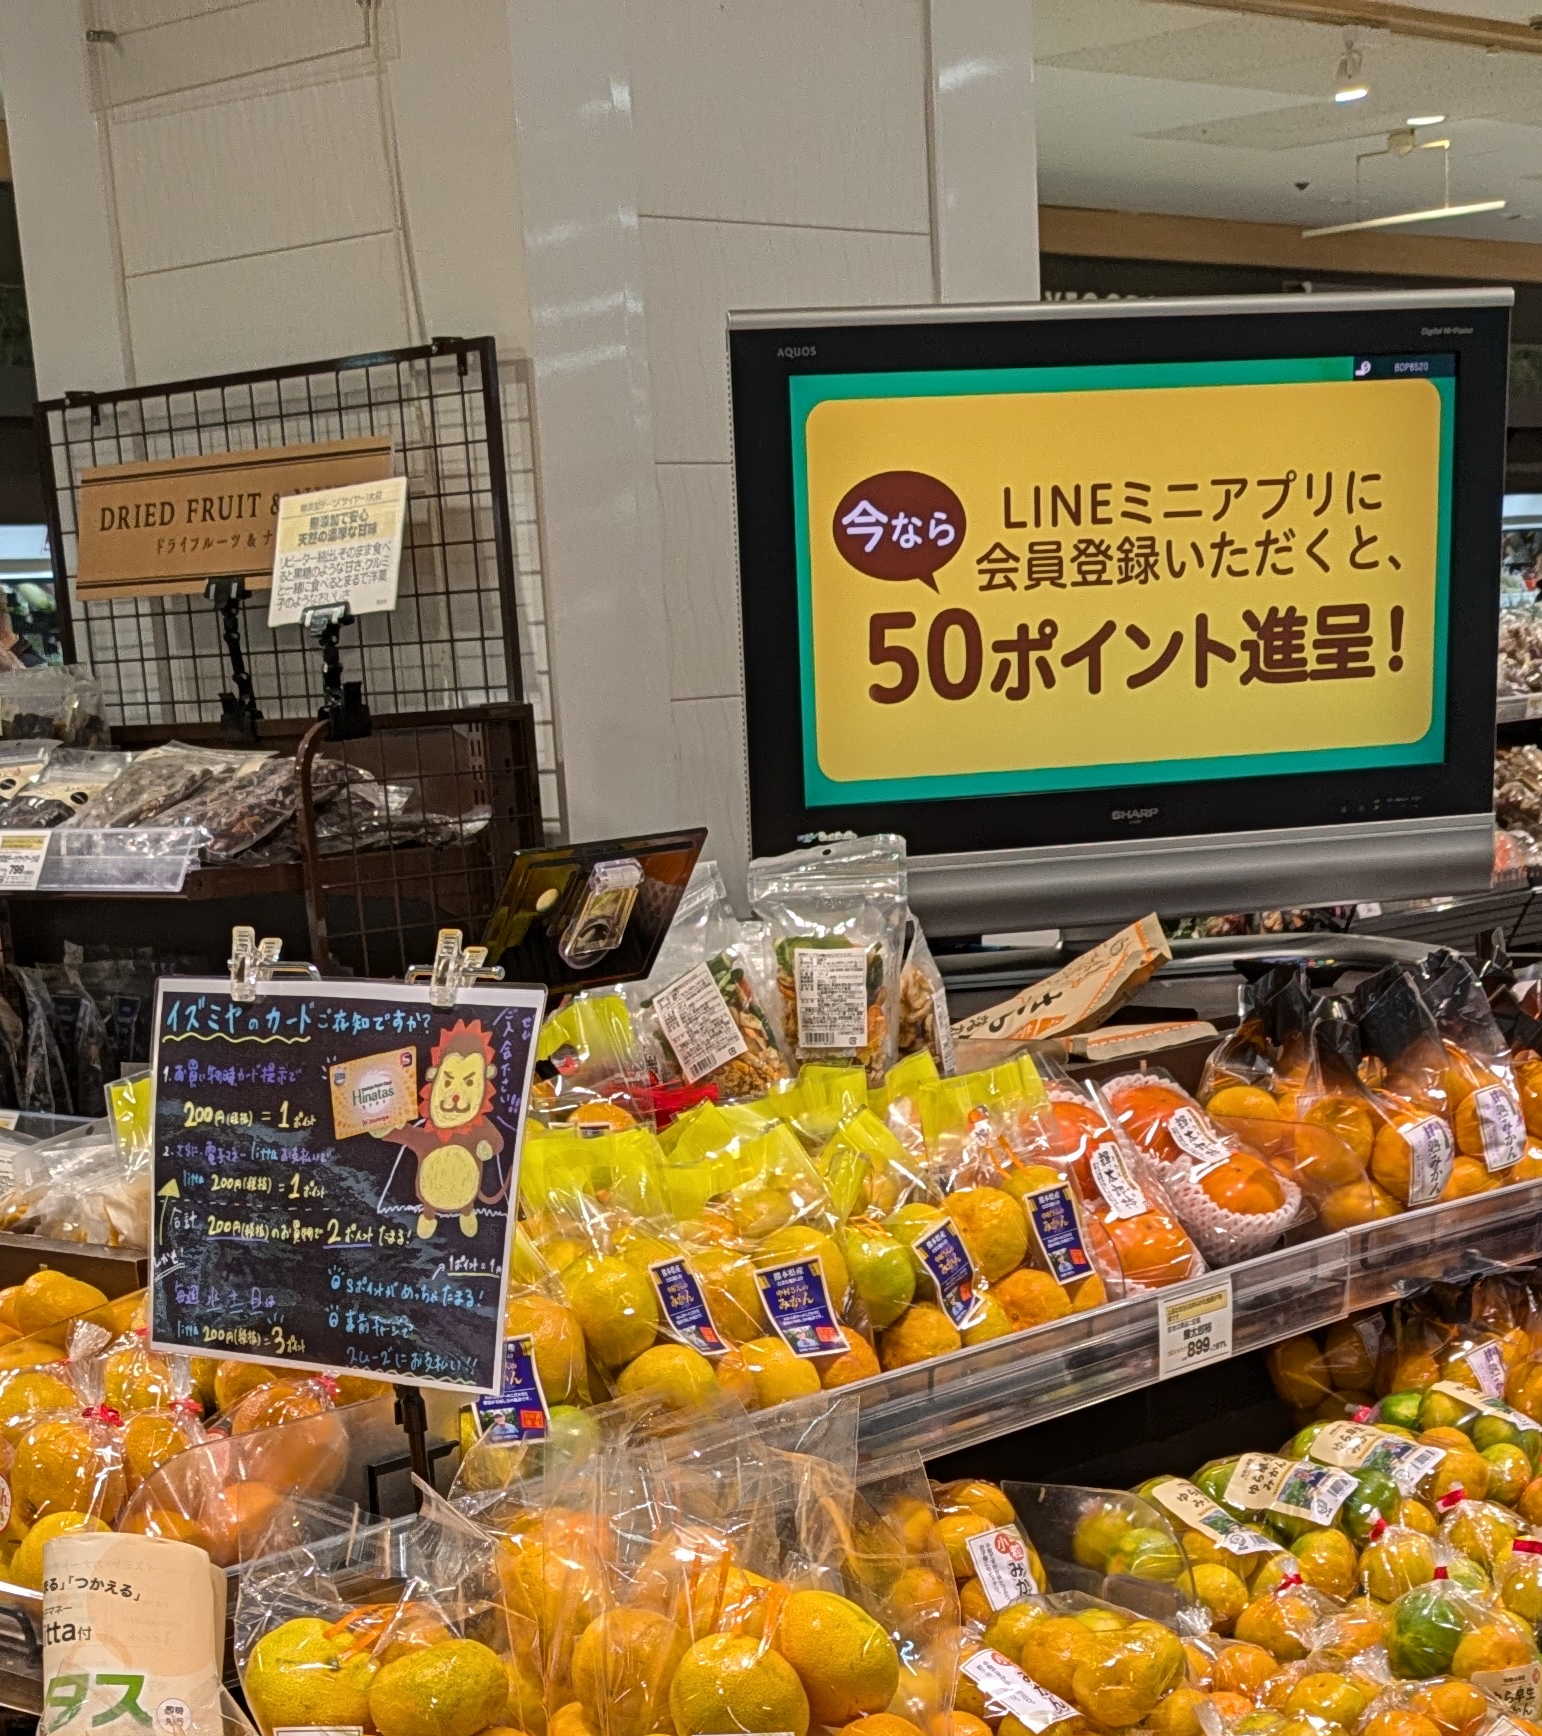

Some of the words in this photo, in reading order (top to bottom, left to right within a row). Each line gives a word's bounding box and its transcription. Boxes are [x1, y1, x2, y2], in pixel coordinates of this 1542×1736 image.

[776, 345, 818, 359] AQUOS
[99, 501, 176, 532] DRIED
[186, 492, 262, 523] FRUIT
[1002, 469, 1385, 532] LINEミニアプリに
[840, 498, 956, 554] 今なら
[157, 534, 241, 555] ドライフルーツ
[975, 530, 1405, 594] 会員登録いただくと、
[868, 601, 1406, 705] 50ポイント進呈！
[1111, 807, 1159, 822] SHARP
[352, 1084, 396, 1107] Hinatas
[778, 1294, 814, 1312] みかん
[1185, 1336, 1211, 1357] 899
